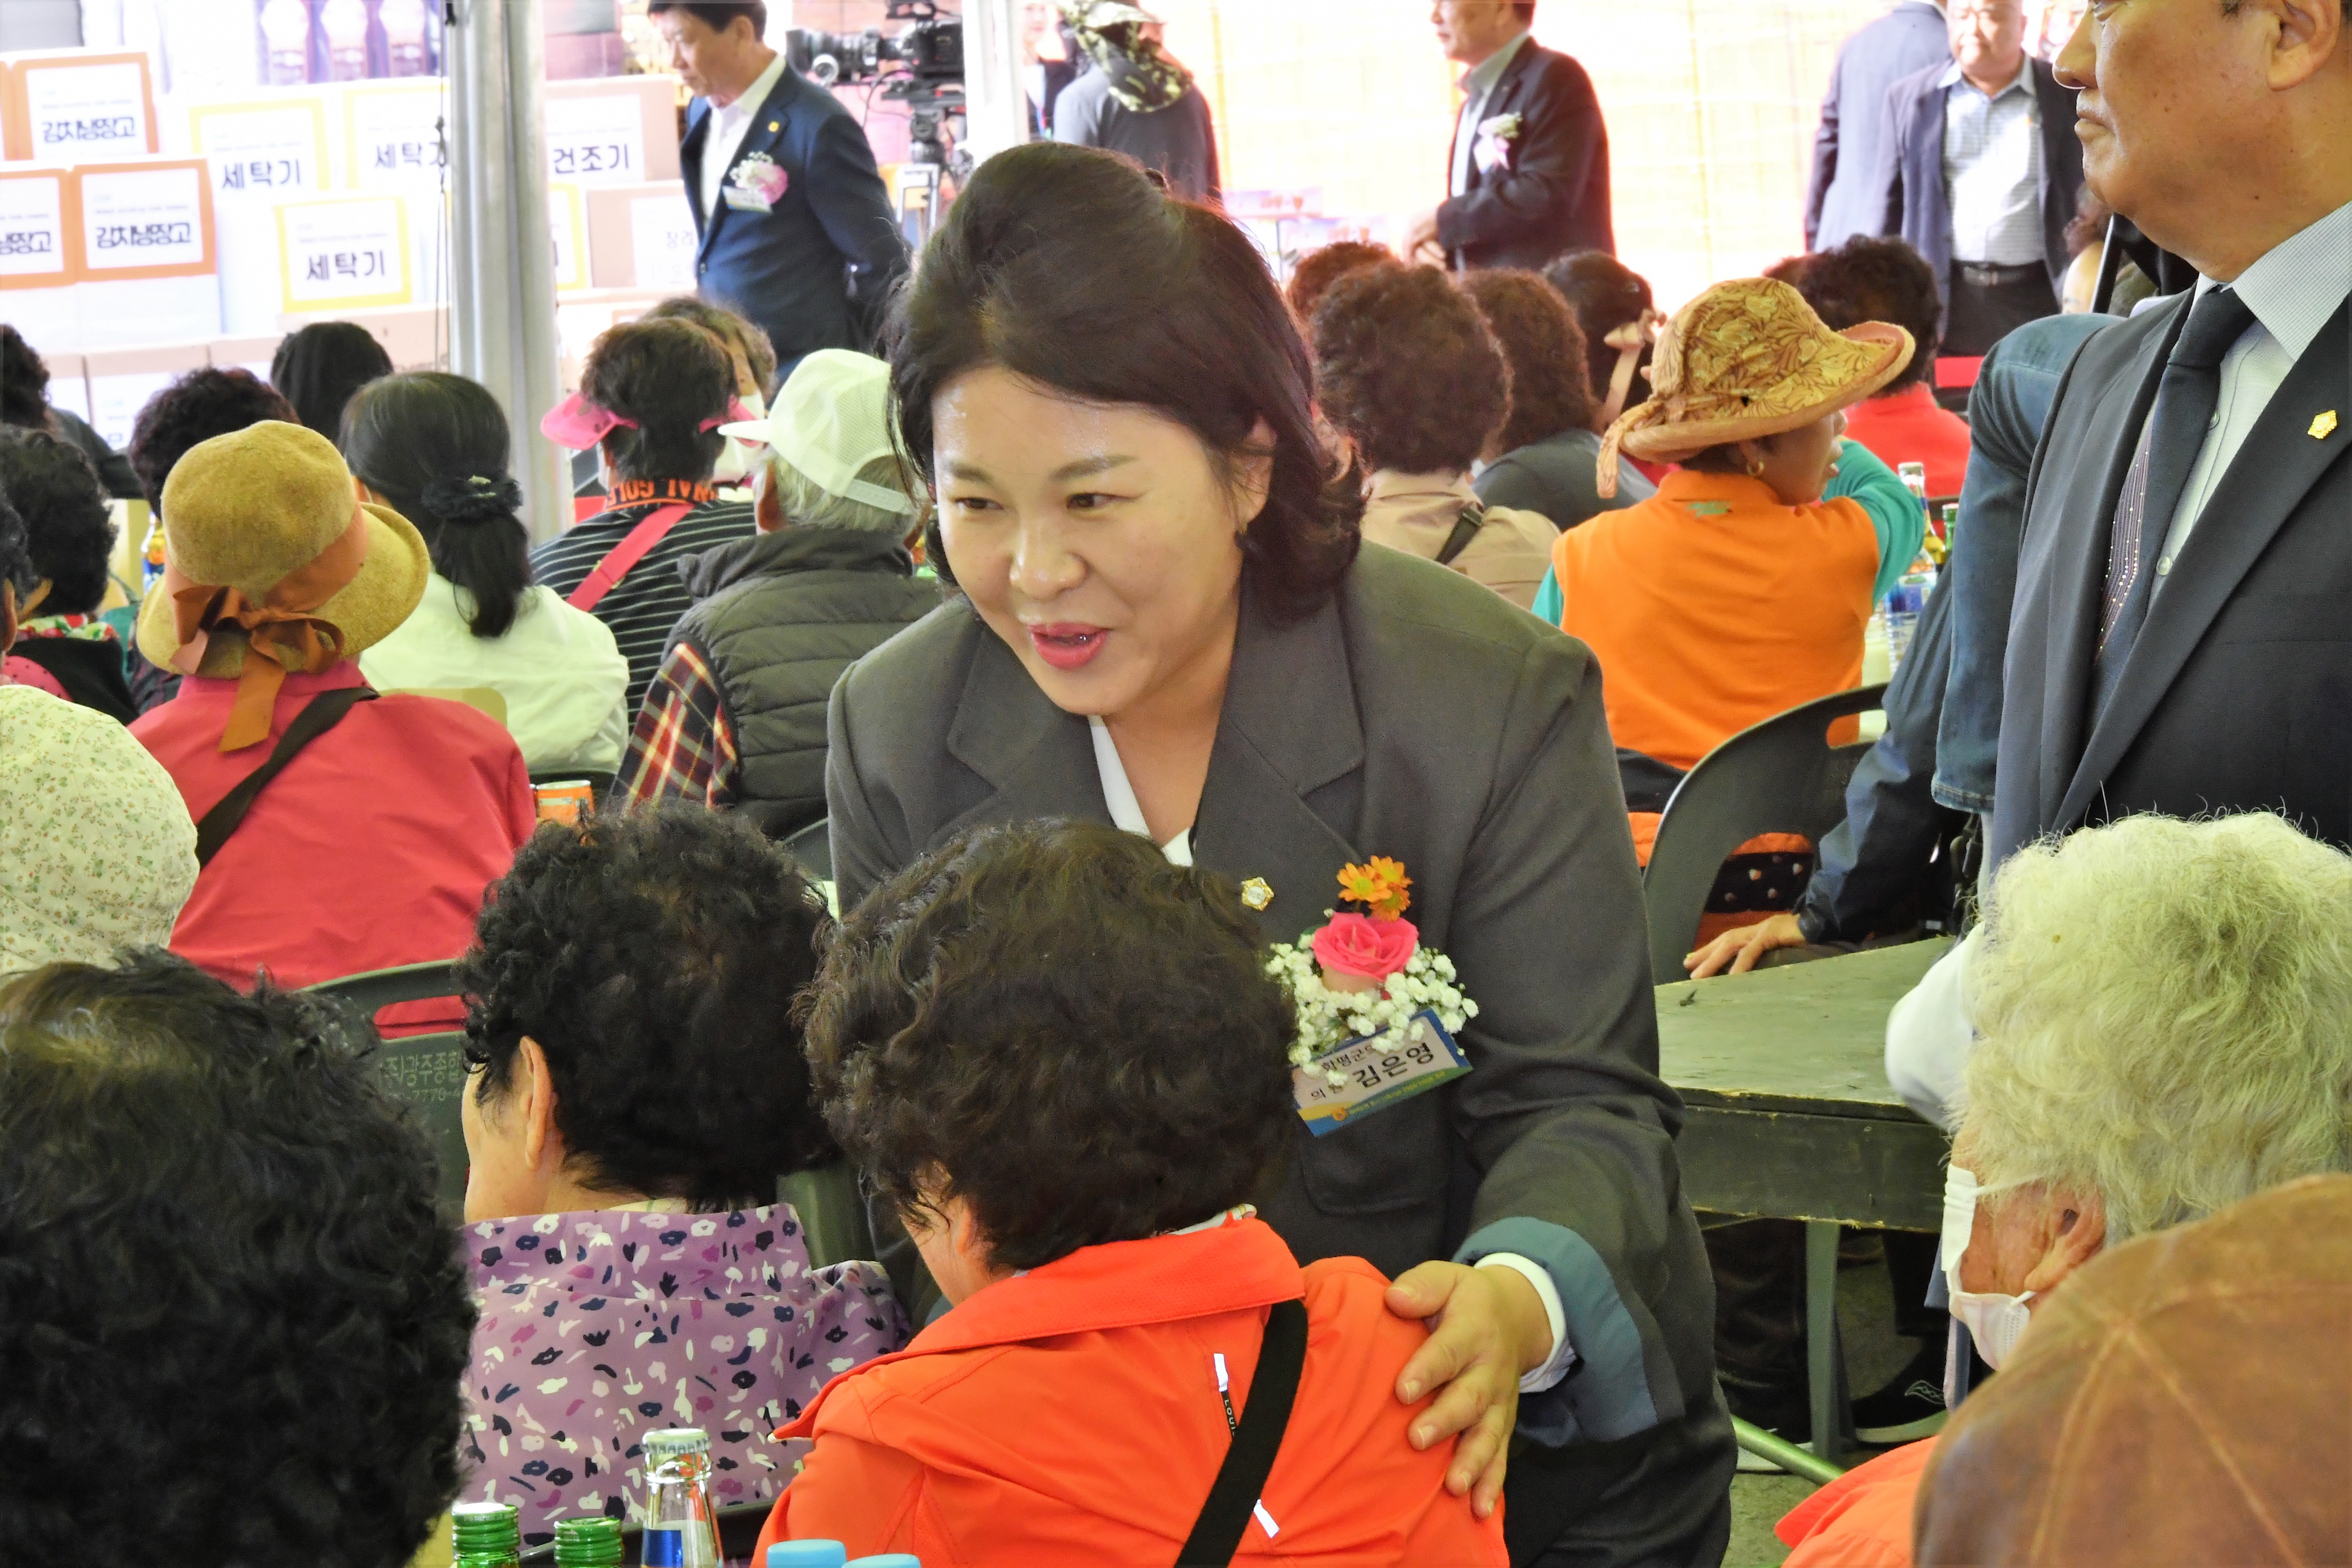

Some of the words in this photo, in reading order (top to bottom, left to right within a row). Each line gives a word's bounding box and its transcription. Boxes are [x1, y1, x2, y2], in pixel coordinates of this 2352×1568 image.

[42, 117, 135, 142] 김치냉장고
[554, 144, 629, 174] 건조기
[222, 159, 301, 190] 세탁기
[96, 223, 191, 248] 김치냉장고
[307, 250, 385, 280] 세탁기
[1353, 1043, 1434, 1088] 김은영
